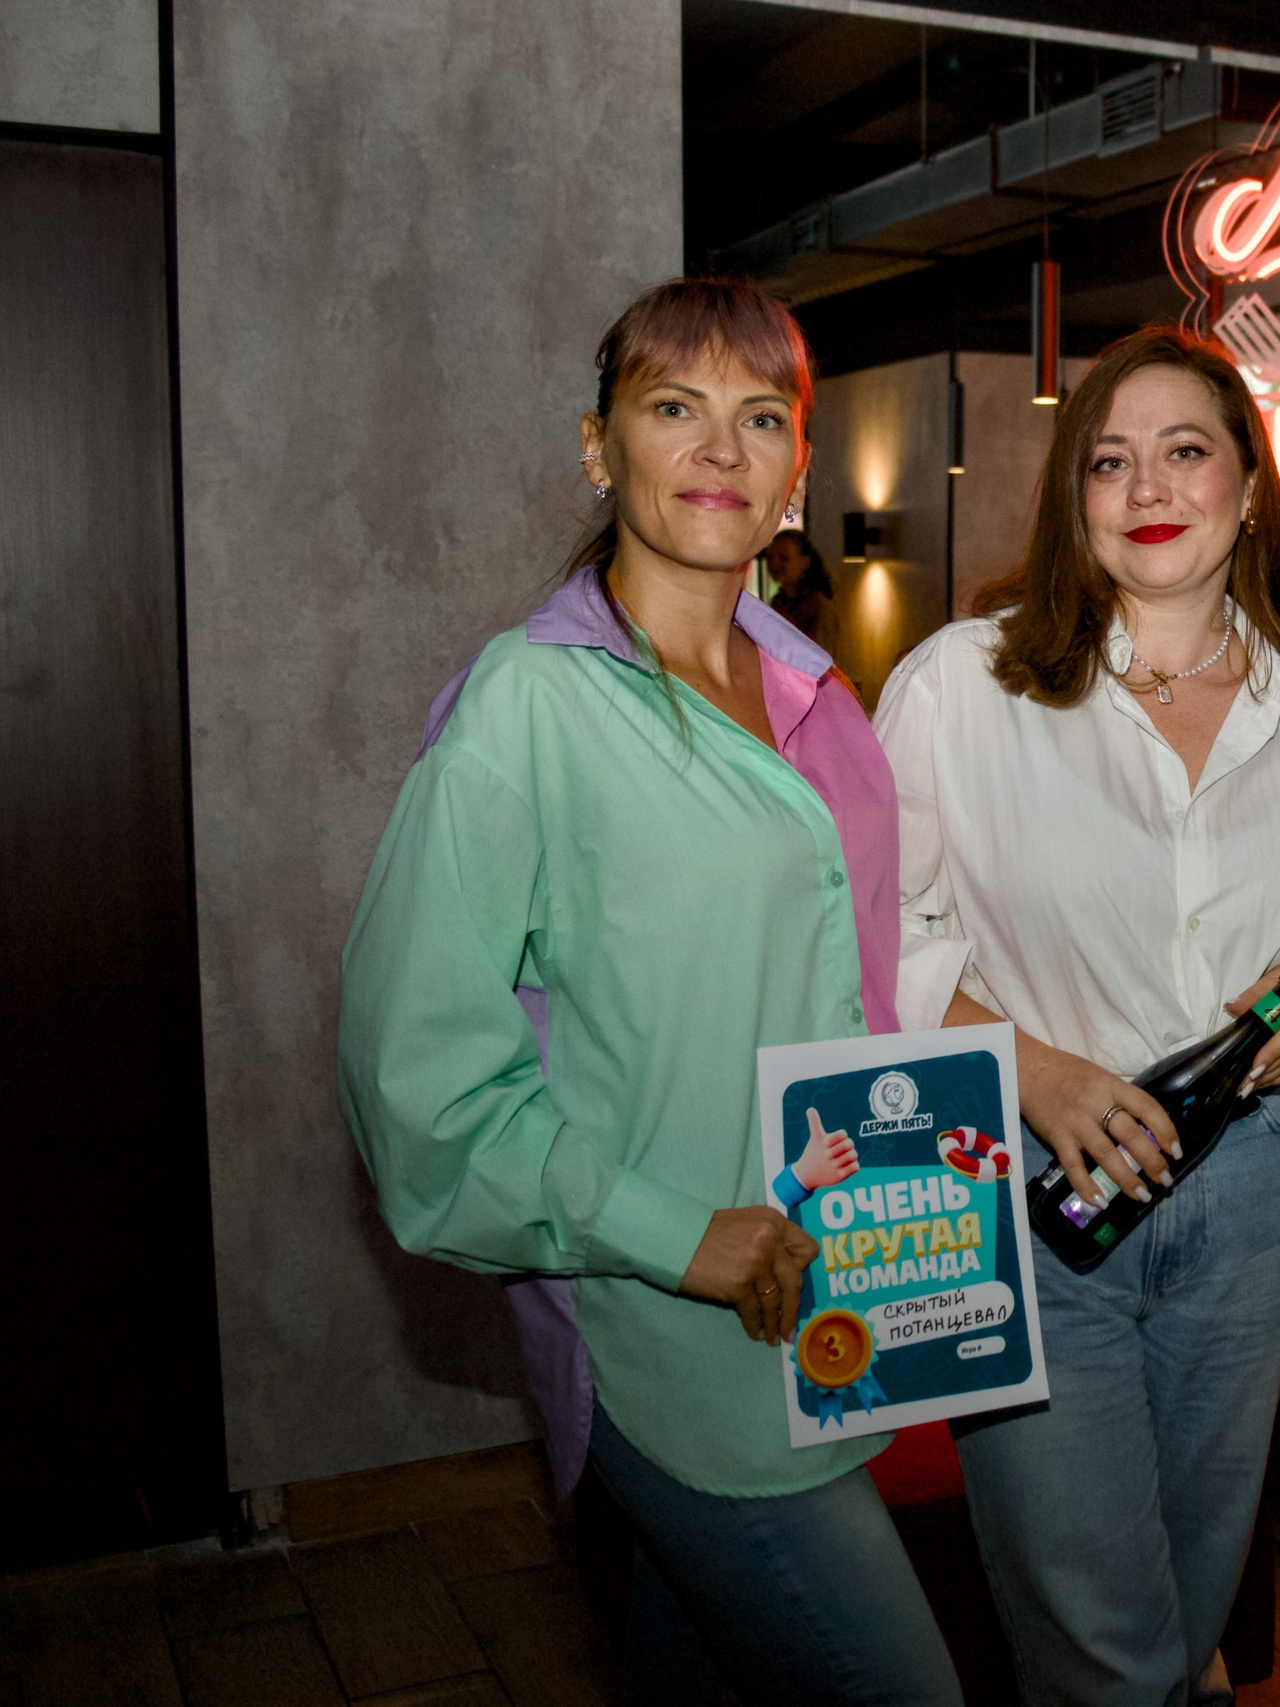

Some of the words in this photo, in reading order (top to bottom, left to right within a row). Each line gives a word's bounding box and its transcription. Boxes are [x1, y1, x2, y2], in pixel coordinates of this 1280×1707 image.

[861, 1120, 899, 1135] ДЕРЖИ
[901, 1115, 932, 1130] ПЯТЬ!
[820, 1174, 971, 1230] ОЧЕНЬ
[821, 1212, 983, 1273] КРУТАЯ
[828, 1248, 982, 1298] КОМАНДА
[883, 1288, 966, 1320] СКРЫТЫЙ
[890, 1304, 1008, 1342] ПОТАНЦЕВАЛ
[823, 1332, 847, 1363] 3
